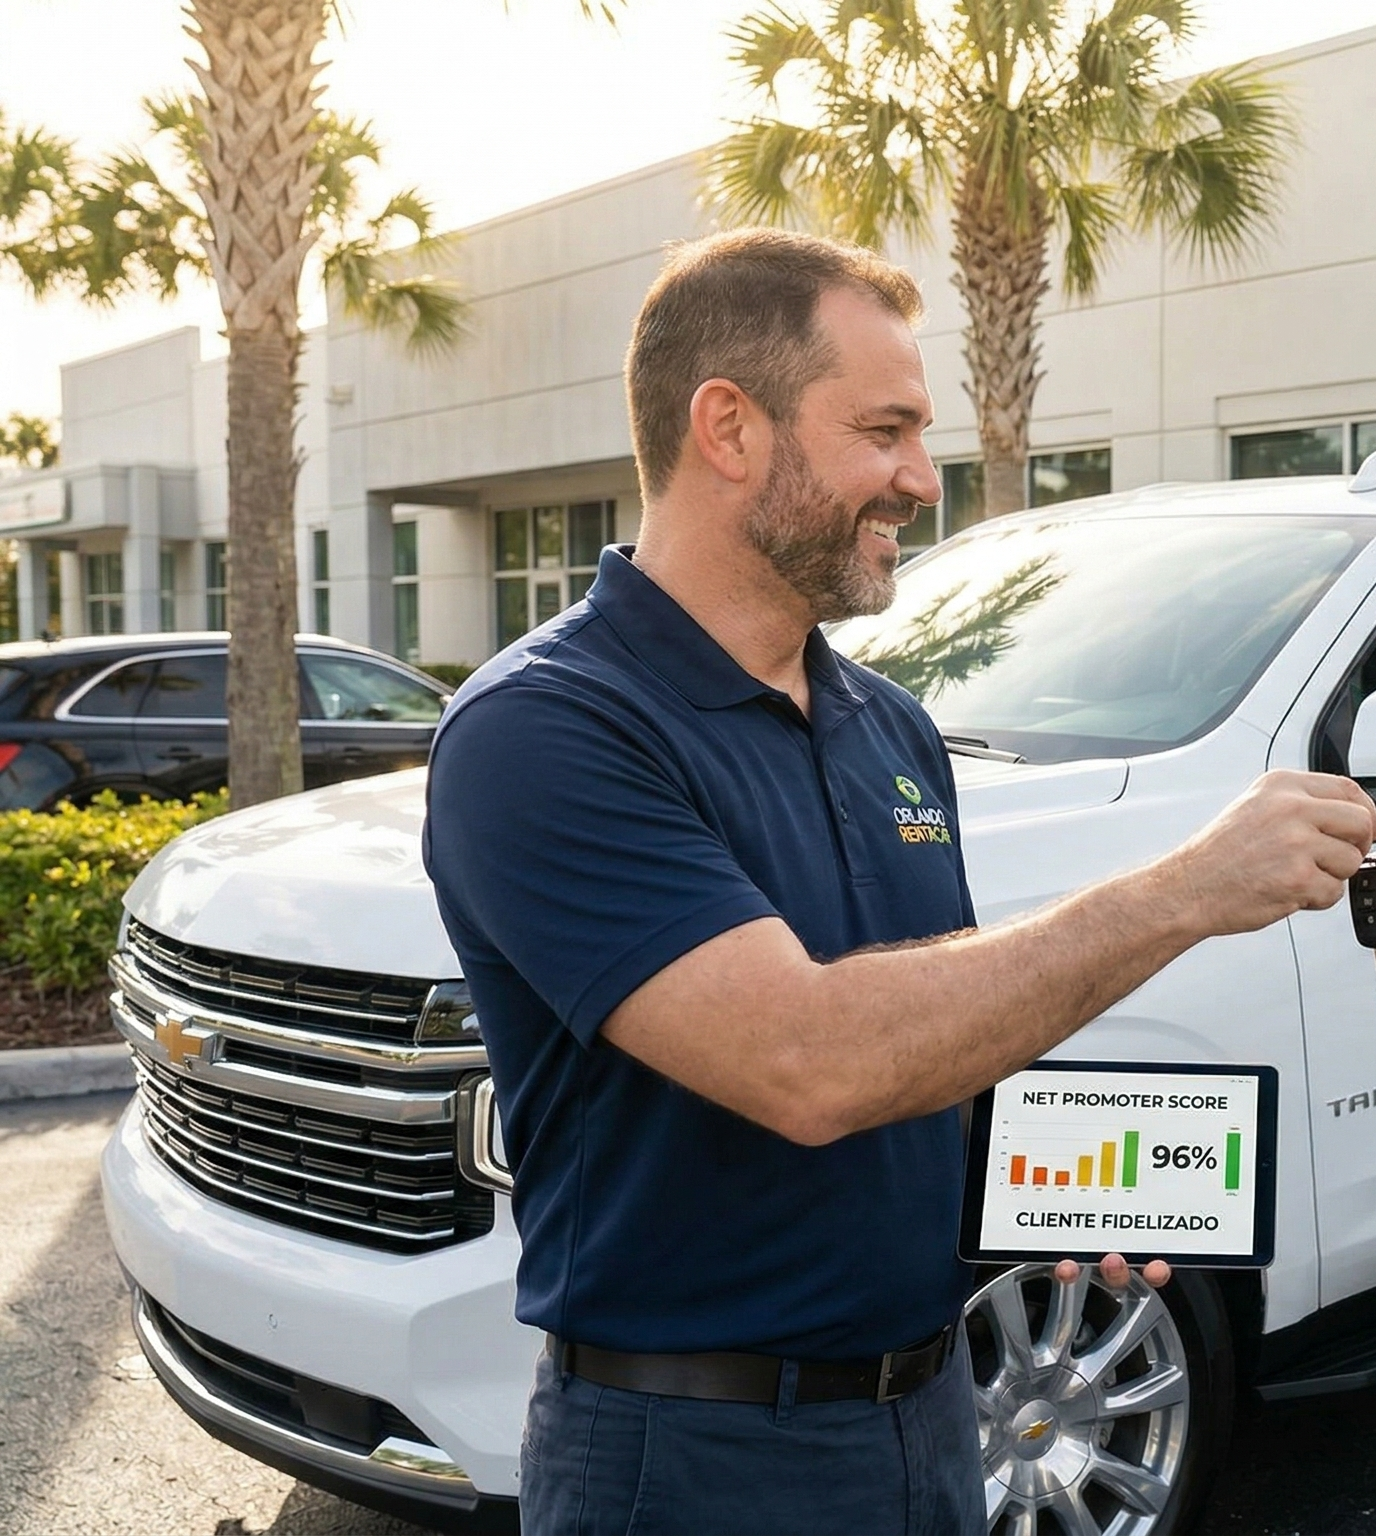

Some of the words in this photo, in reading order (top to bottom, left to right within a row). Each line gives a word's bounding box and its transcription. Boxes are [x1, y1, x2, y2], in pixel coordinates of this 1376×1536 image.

[894, 807, 945, 826] ORLANDO
[1023, 1091, 1058, 1106] NET
[1062, 1093, 1163, 1109] PROMOTER
[1168, 1095, 1228, 1110] SCORE
[1151, 1144, 1217, 1170] 96%
[1016, 1212, 1096, 1229] CLIENTE
[1101, 1213, 1219, 1231] FIDELIZADO
